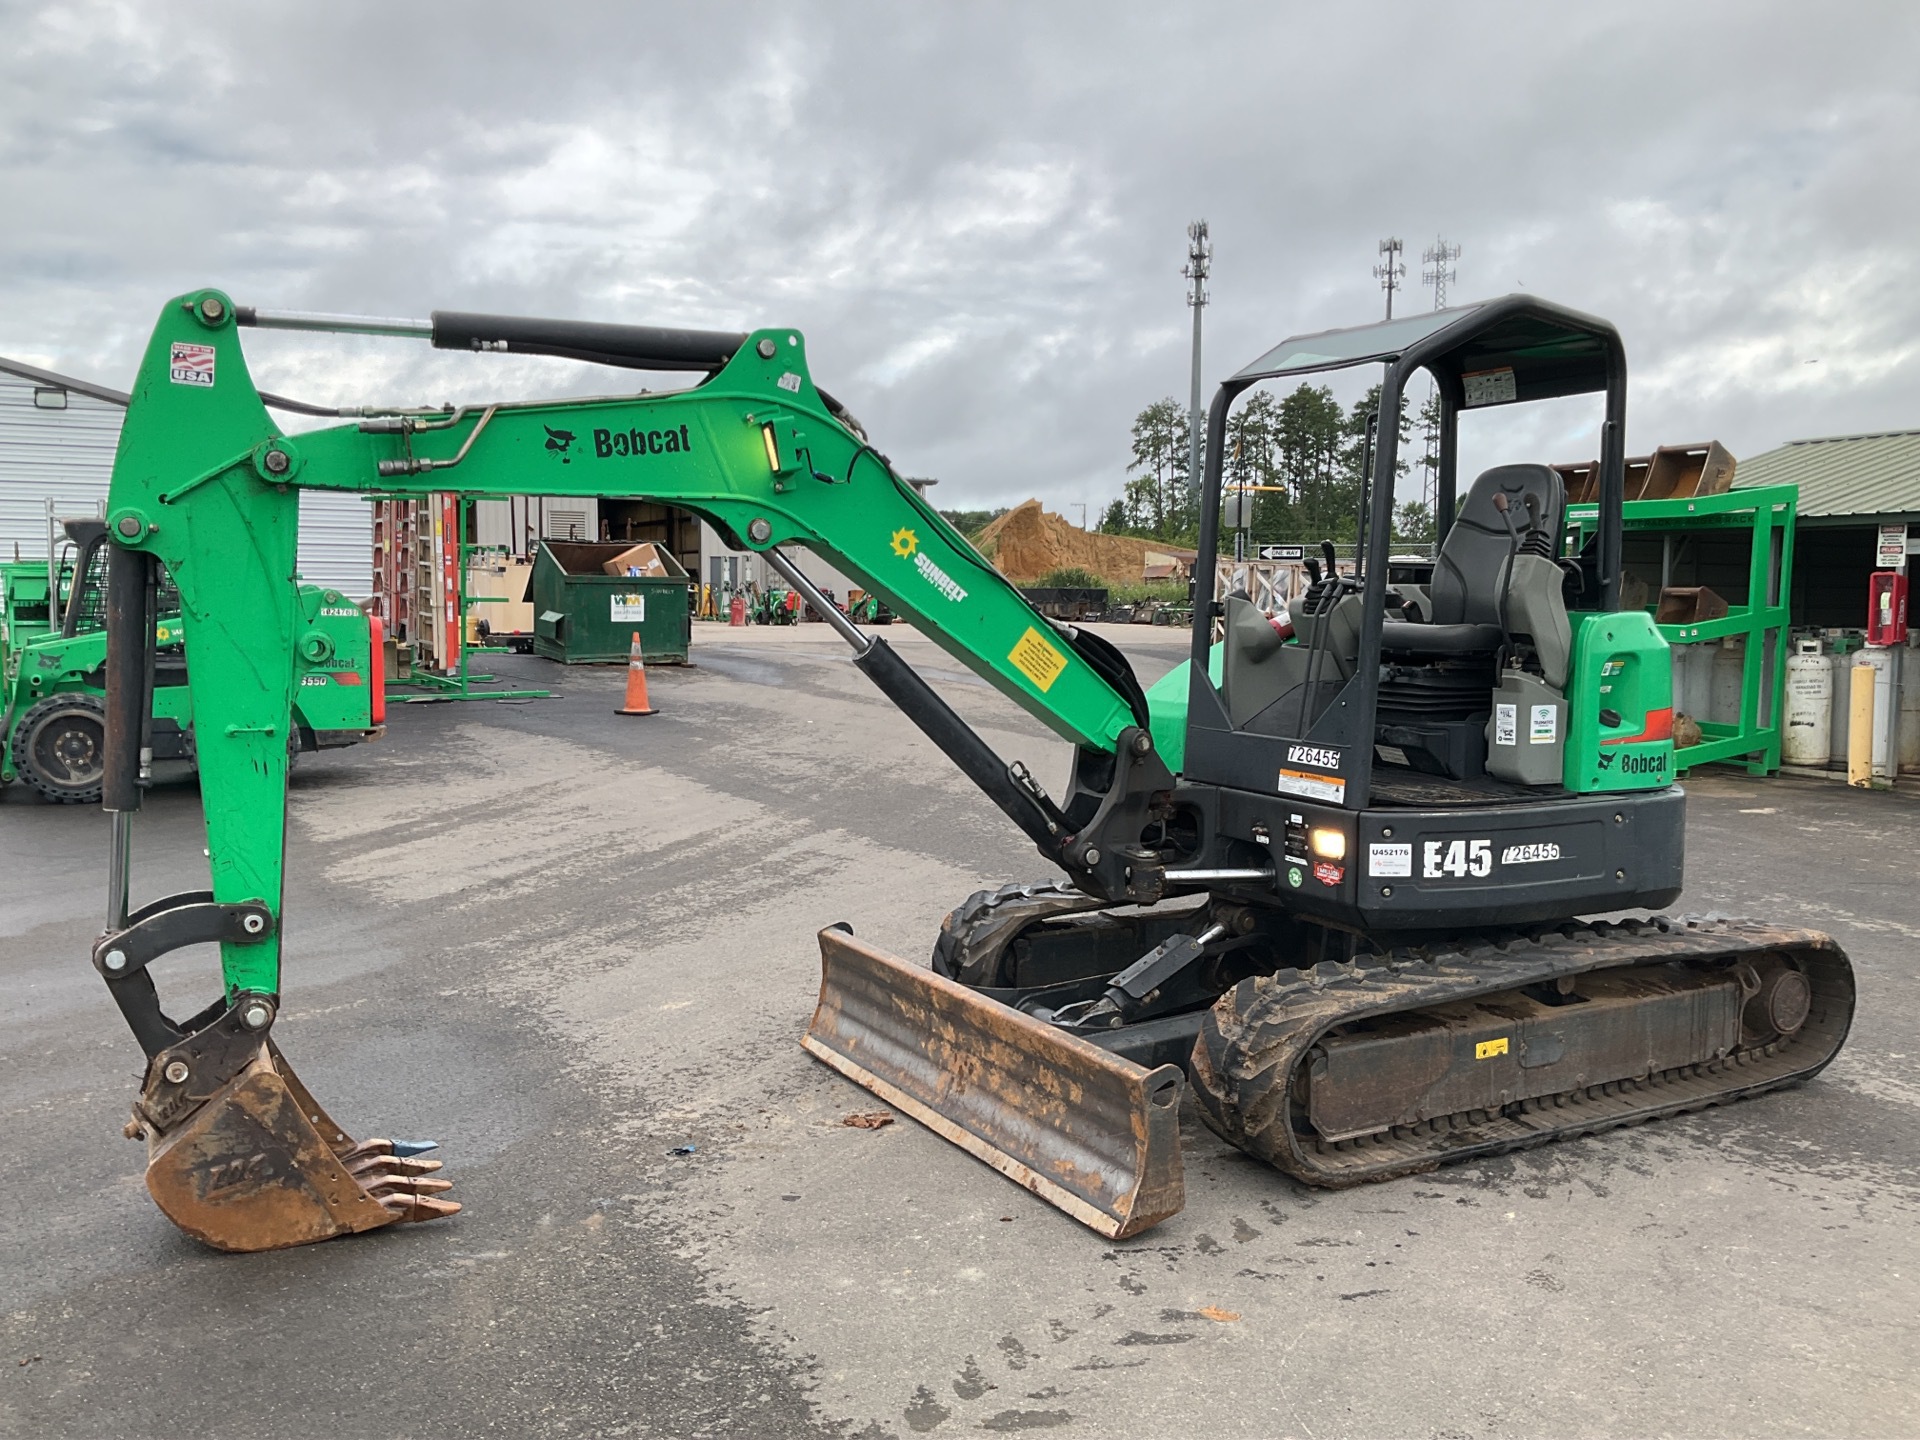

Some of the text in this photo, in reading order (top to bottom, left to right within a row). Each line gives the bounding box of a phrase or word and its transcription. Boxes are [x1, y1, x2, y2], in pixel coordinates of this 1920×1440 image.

[173, 369, 211, 383] USA
[593, 424, 691, 458] Bobcat
[913, 551, 969, 603] SUNBELT
[917, 567, 955, 602] RENTALS
[613, 594, 640, 606] WM
[1290, 746, 1338, 767] 726455
[1622, 752, 1666, 774] Bobcat
[1424, 840, 1492, 877] E45
